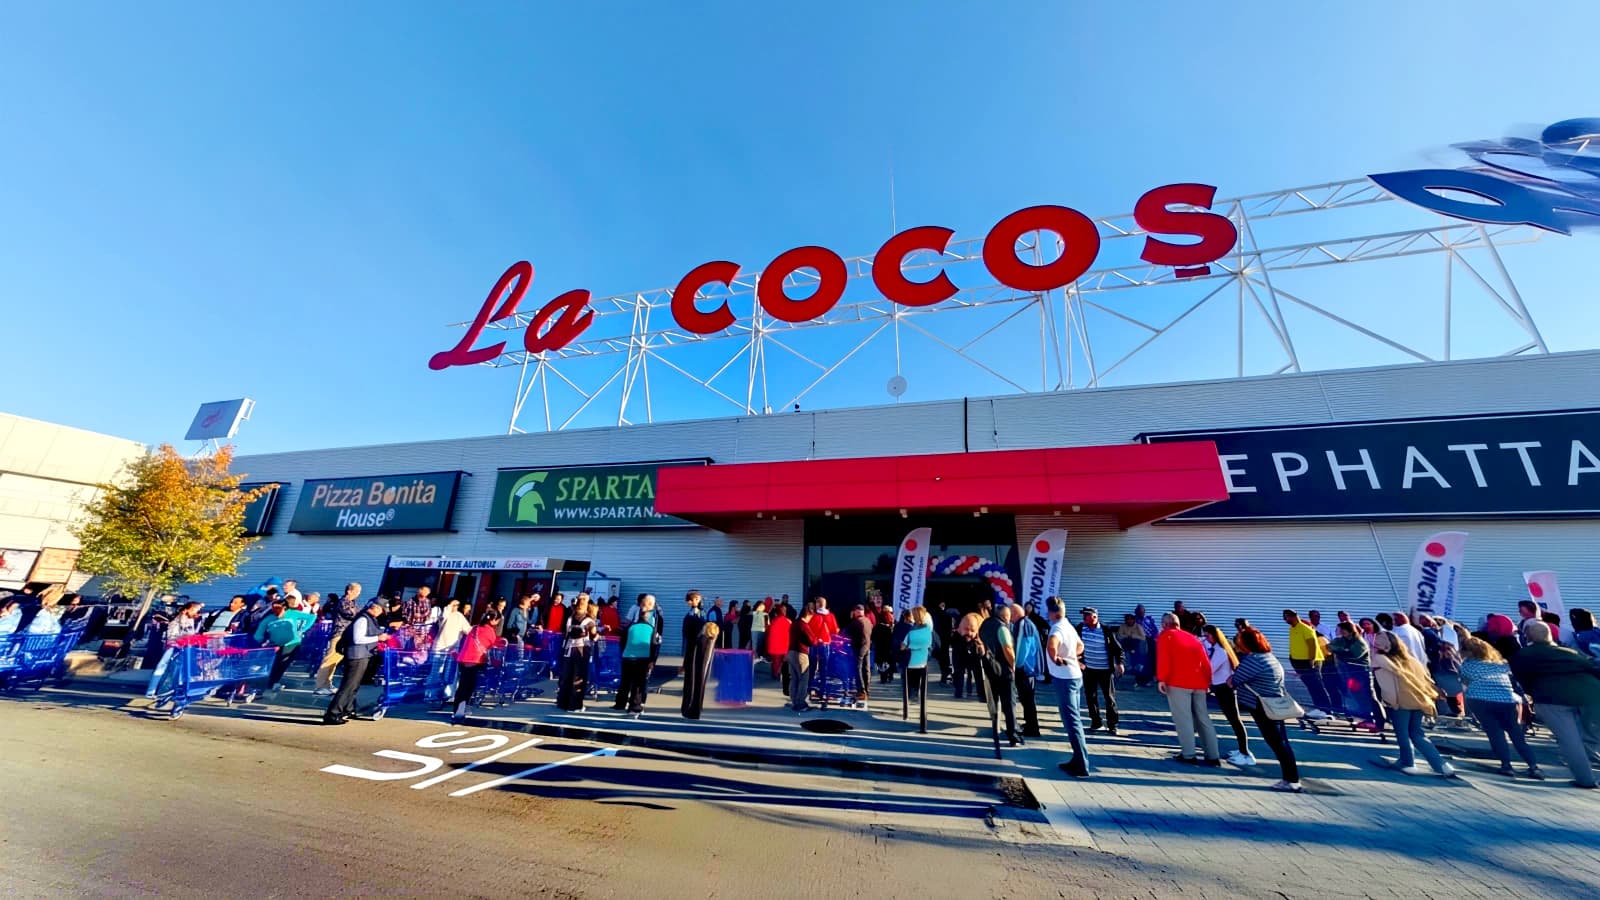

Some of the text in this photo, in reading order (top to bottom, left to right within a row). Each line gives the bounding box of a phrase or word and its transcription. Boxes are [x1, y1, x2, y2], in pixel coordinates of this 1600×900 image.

[429, 261, 594, 370] La
[312, 479, 437, 508] Pizza Bonita
[556, 474, 656, 501] SPARTA
[554, 506, 668, 519] WWW.SPARTAN
[1030, 556, 1048, 614] RNOVA
